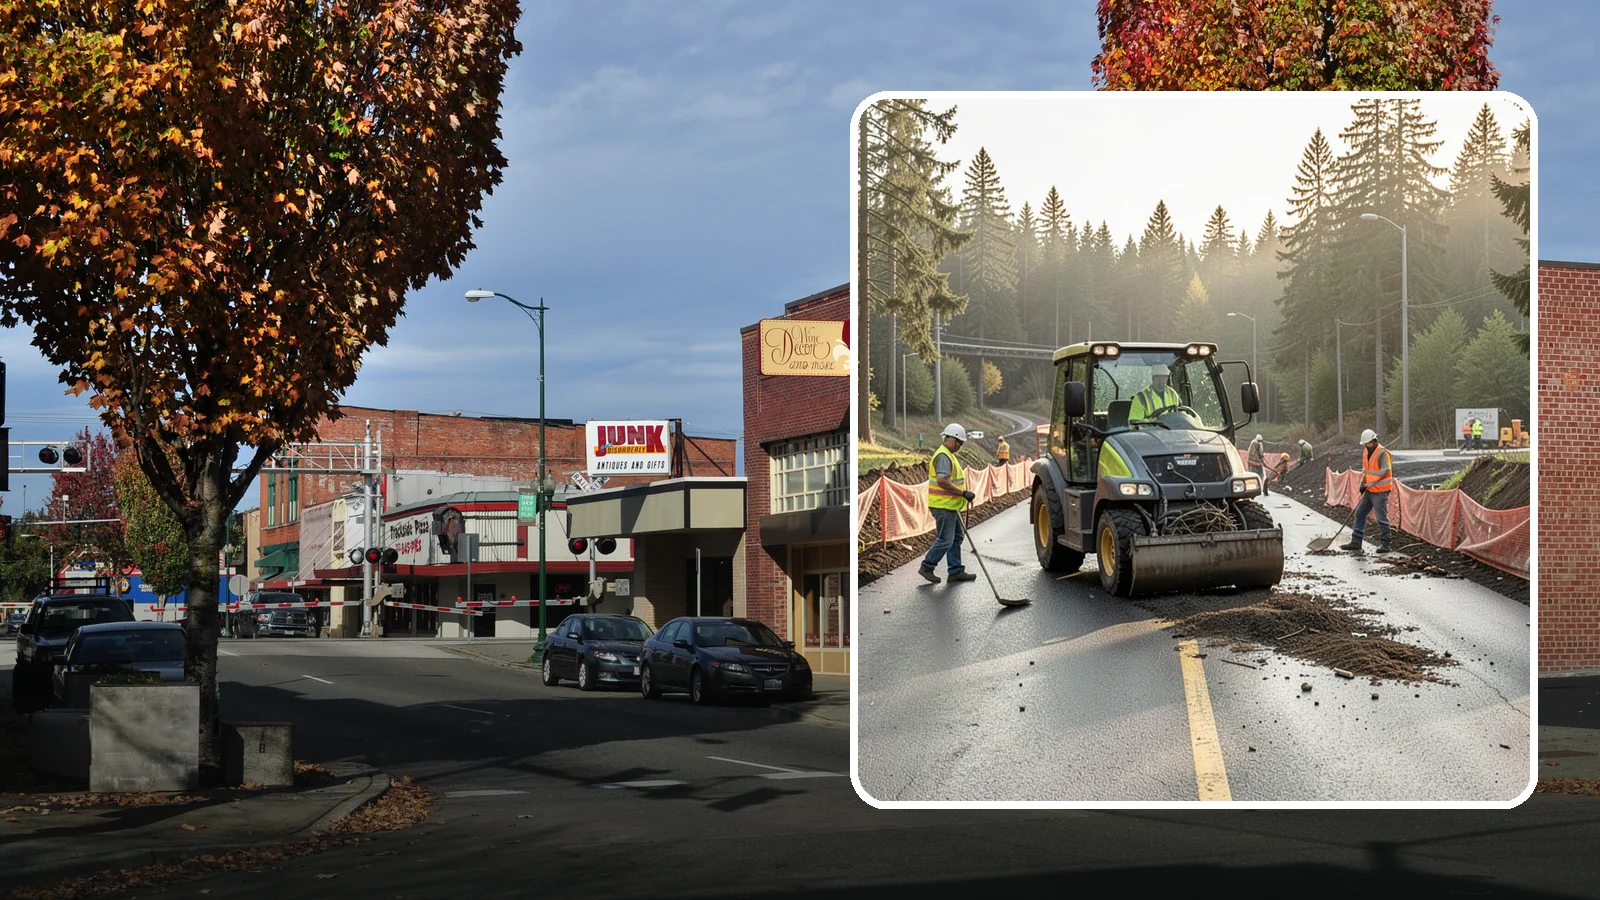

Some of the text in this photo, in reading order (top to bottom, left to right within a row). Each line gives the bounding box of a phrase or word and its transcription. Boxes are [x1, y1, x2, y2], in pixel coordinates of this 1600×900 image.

[596, 426, 665, 457] JUNK
[597, 460, 665, 470] ANTIQUES AND GIFTS
[414, 519, 429, 535] Pizza
